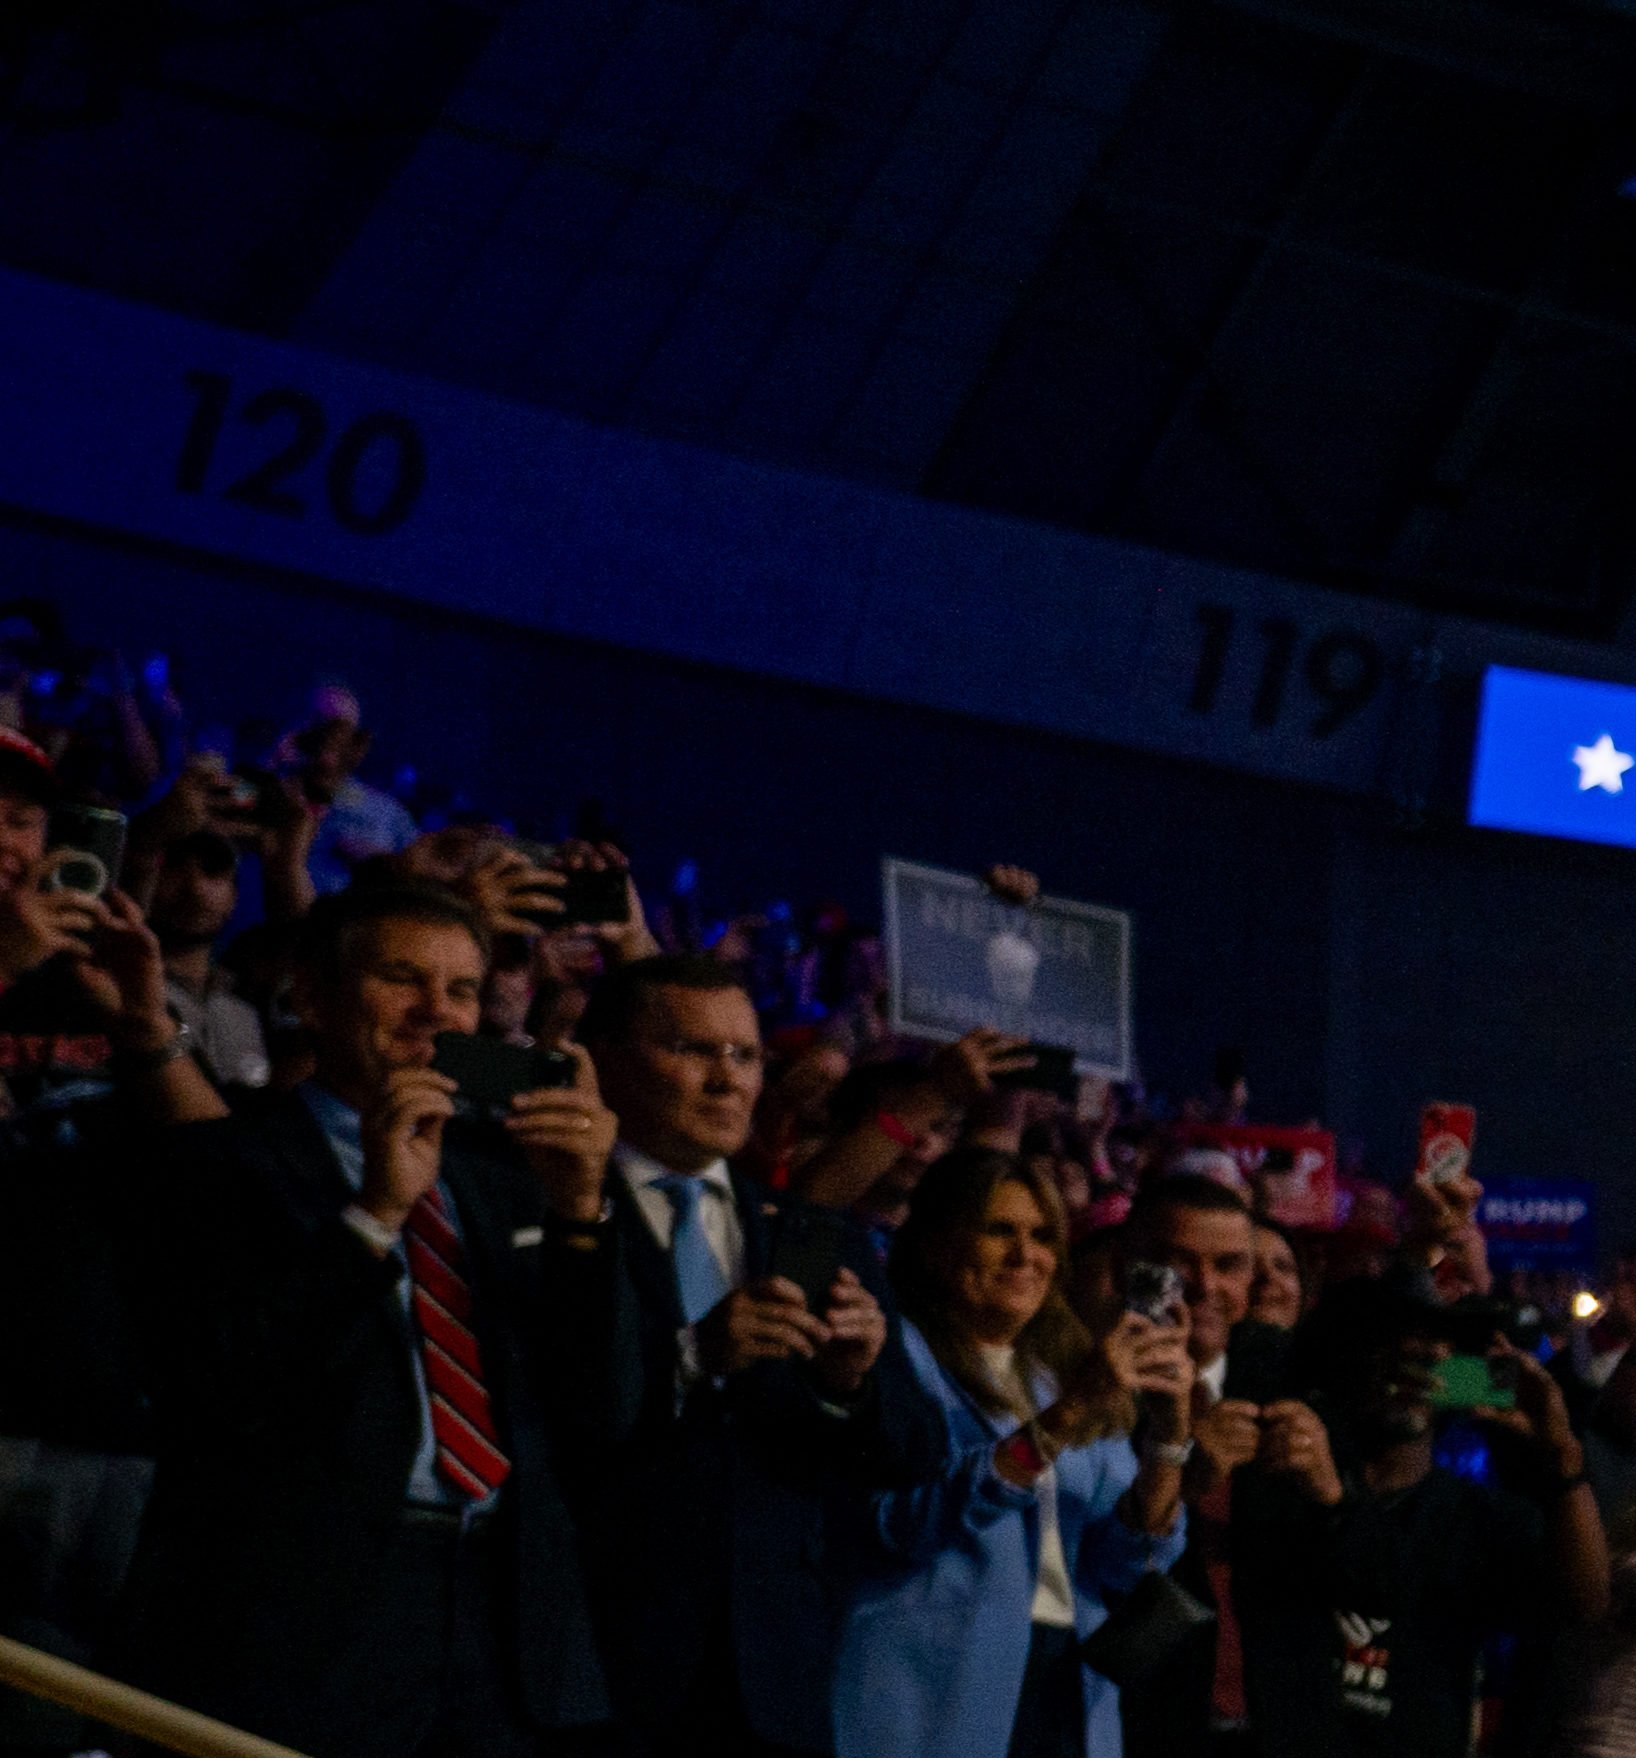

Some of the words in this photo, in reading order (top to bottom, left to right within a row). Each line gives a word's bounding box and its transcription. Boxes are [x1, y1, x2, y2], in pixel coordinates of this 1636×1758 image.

[173, 370, 424, 536] 120
[1192, 602, 1378, 738] 119
[1485, 1199, 1587, 1224] RUMP
